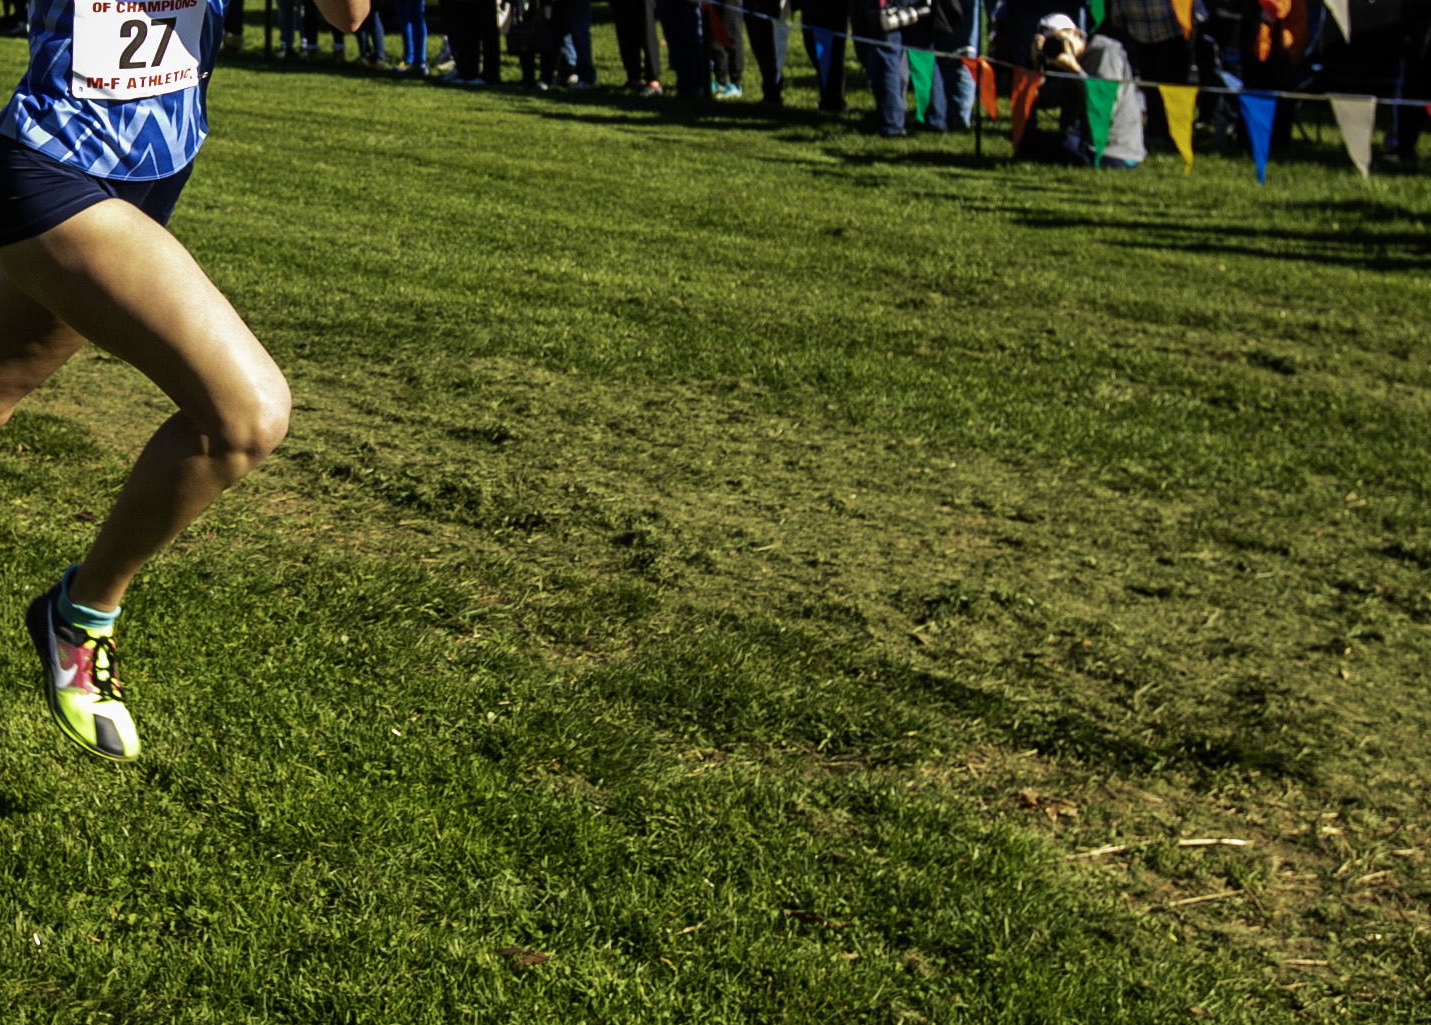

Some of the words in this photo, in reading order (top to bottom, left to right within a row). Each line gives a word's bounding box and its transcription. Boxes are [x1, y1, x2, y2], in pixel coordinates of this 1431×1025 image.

[92, 1, 111, 13] OF
[119, 16, 177, 69] 27
[87, 77, 121, 90] M-F
